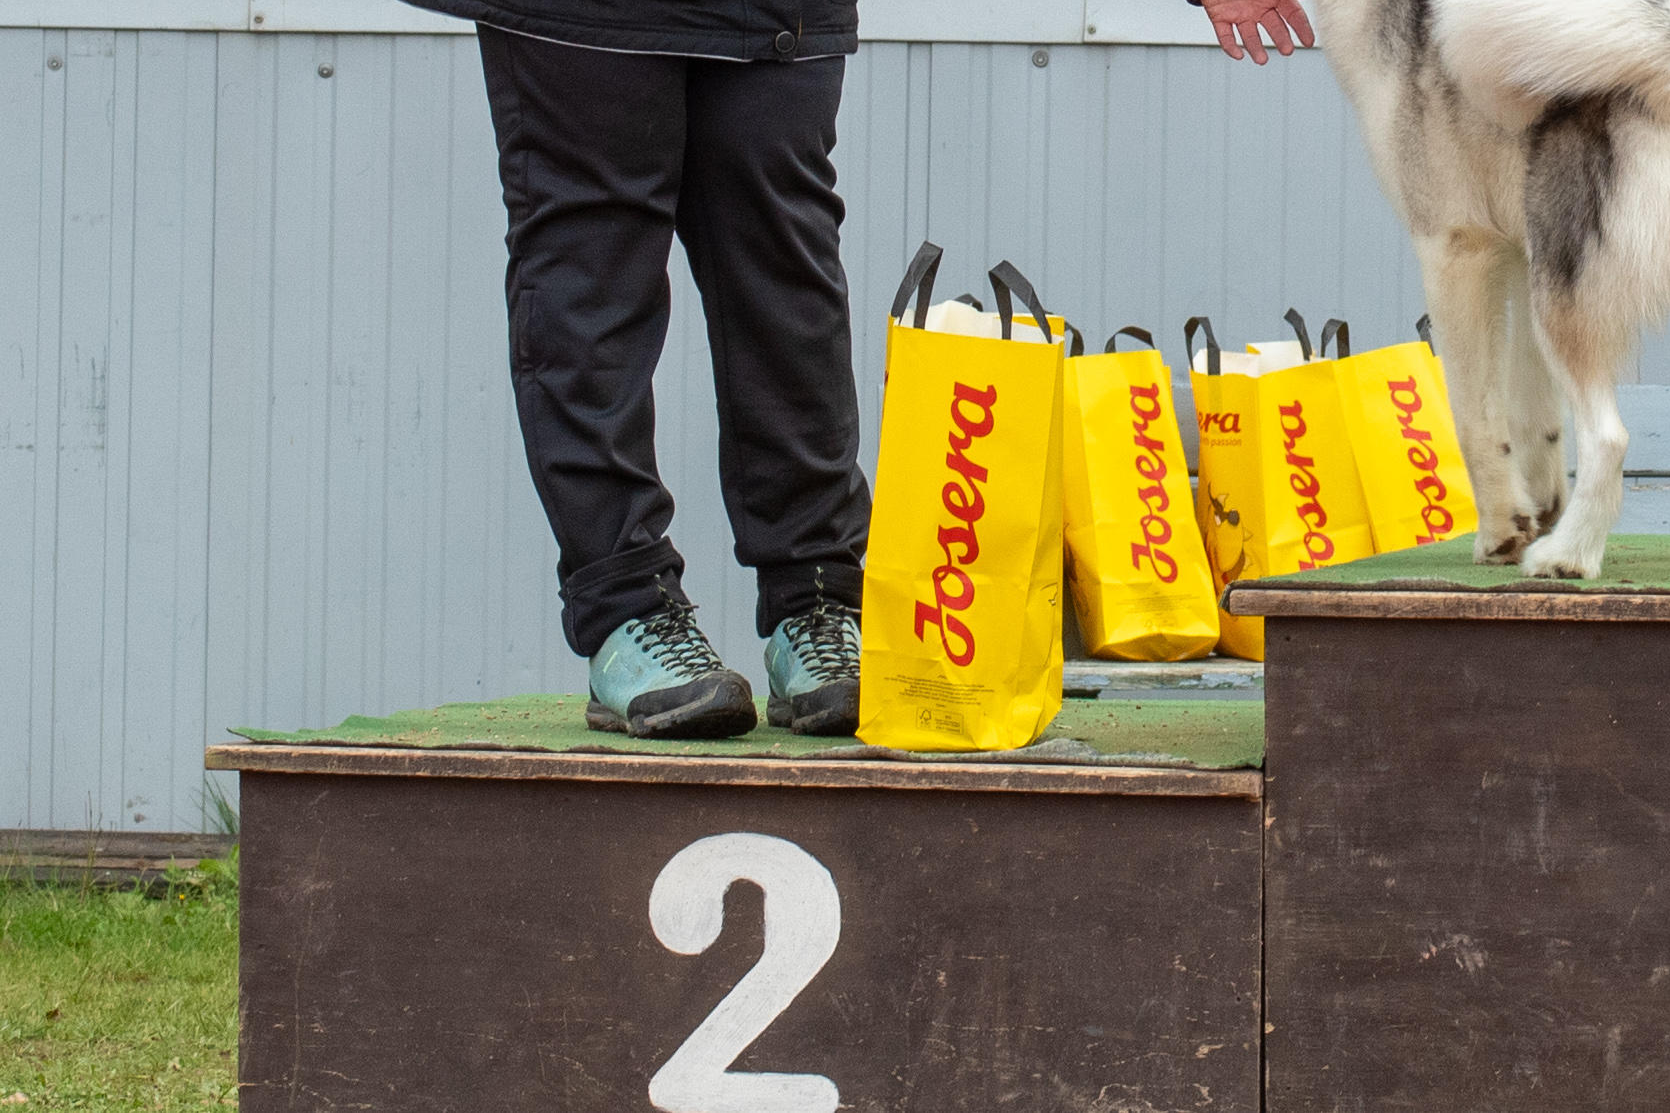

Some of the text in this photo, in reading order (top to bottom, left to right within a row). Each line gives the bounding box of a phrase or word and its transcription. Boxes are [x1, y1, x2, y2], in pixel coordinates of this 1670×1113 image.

[914, 381, 998, 667] Josera
[1130, 382, 1179, 584] Josera
[648, 831, 842, 1113] 2
